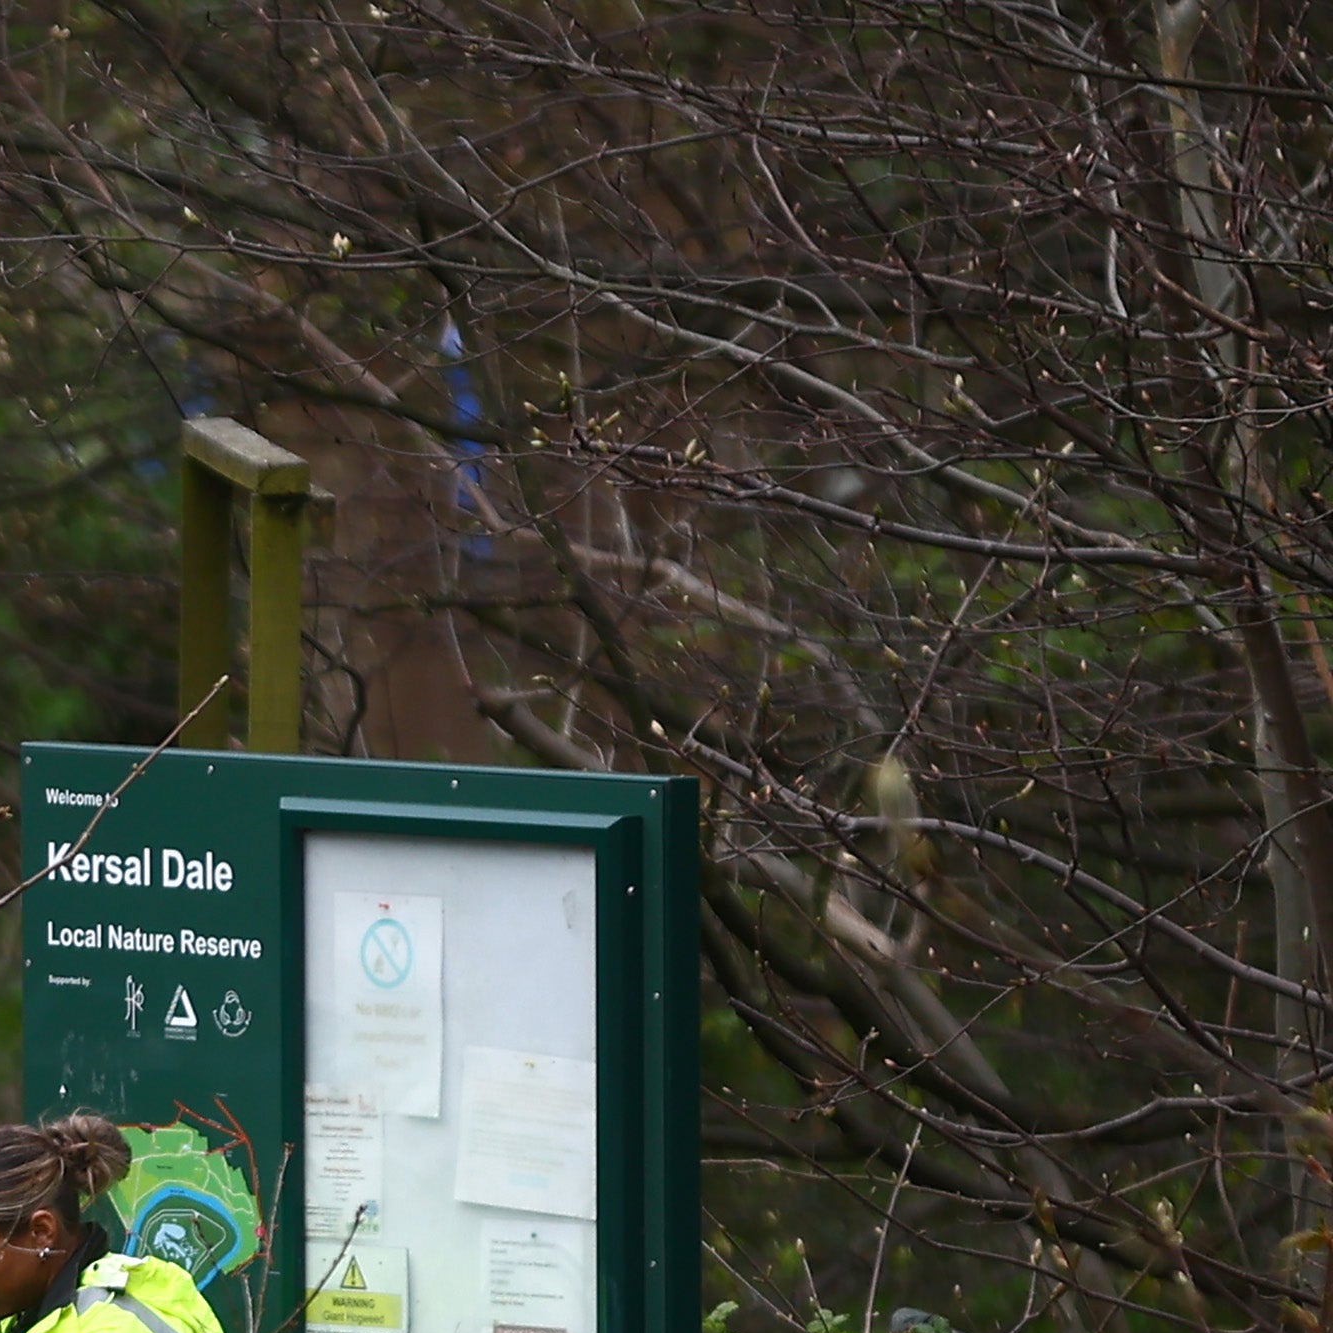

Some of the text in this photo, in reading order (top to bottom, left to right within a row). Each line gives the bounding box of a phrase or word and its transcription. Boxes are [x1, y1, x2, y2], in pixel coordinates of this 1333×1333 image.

[46, 788, 119, 808] Welcome to
[47, 841, 233, 892] Kersal Dale
[47, 920, 262, 959] Local Nature Reserve
[48, 974, 81, 986] Supported
[332, 1297, 375, 1309] WARNING
[323, 1309, 345, 1322] Giant
